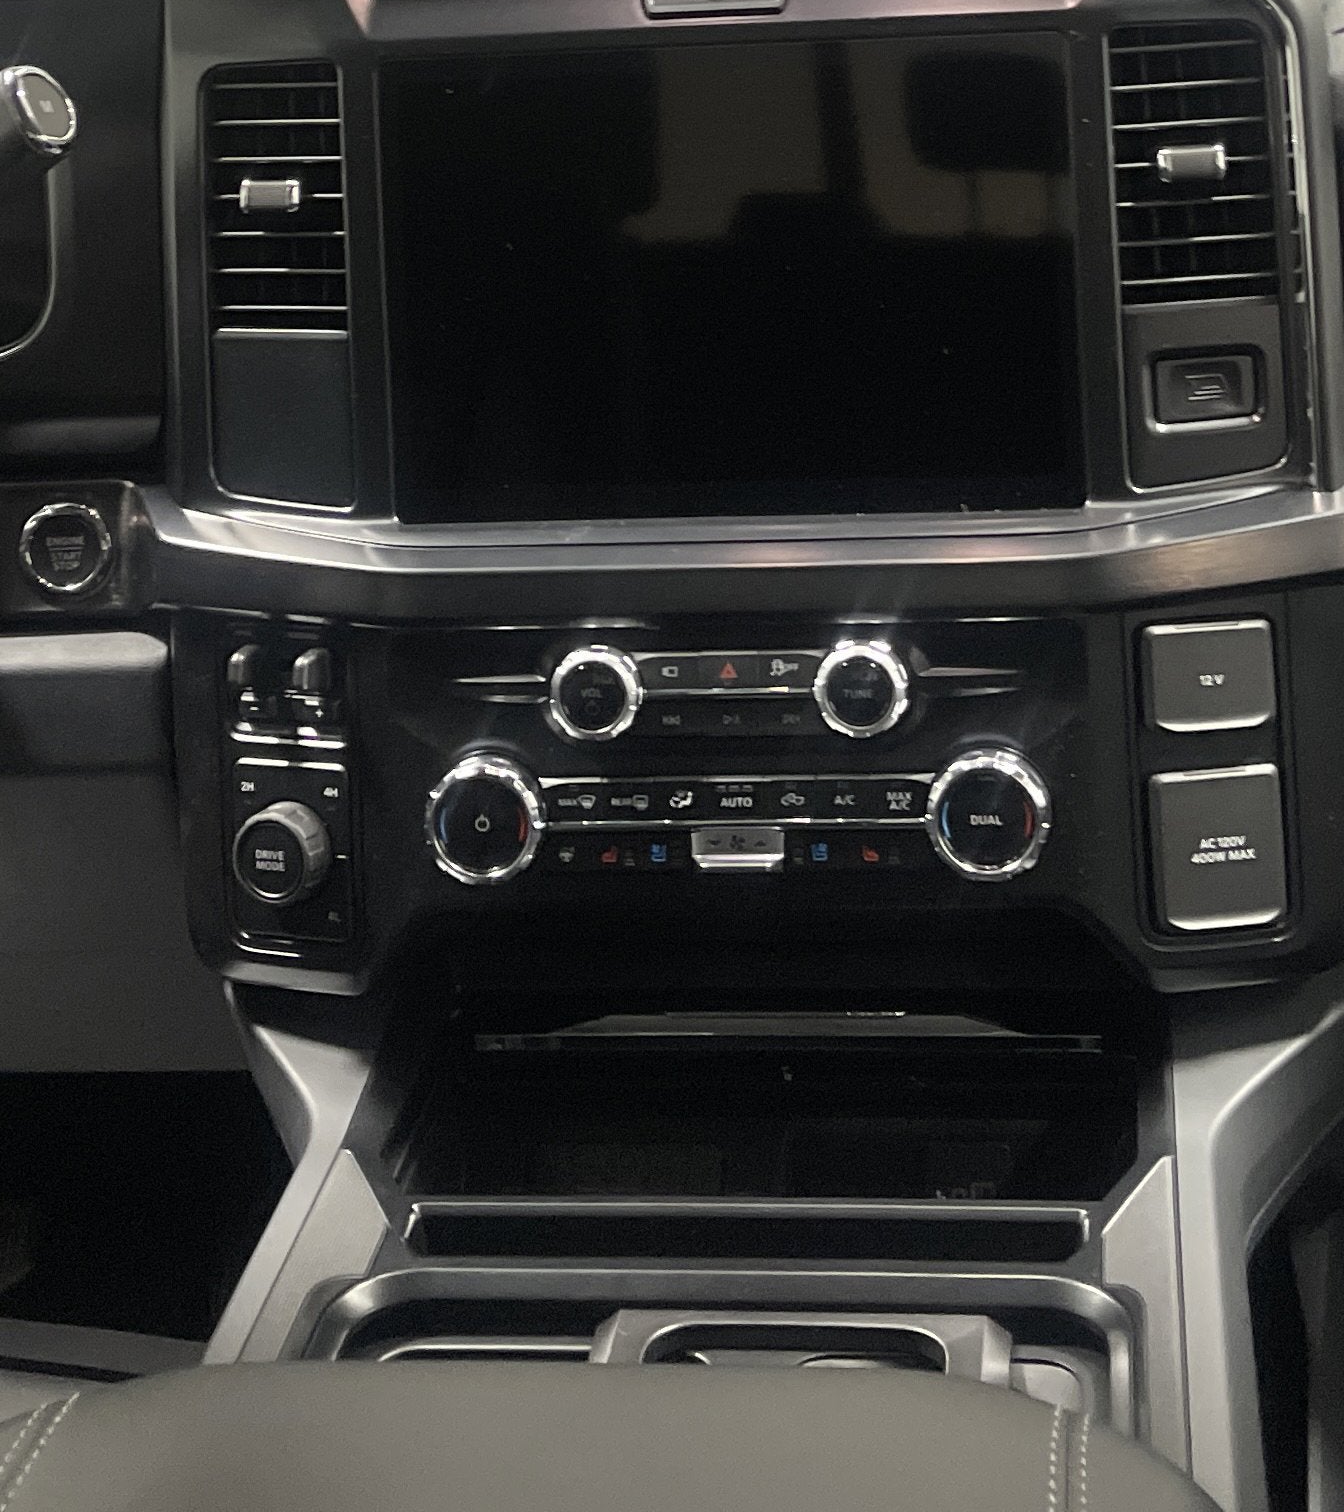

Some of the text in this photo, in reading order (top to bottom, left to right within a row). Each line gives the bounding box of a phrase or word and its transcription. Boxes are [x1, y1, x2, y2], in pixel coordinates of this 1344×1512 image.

[240, 781, 255, 792] 2H
[323, 787, 339, 798] 4H
[720, 796, 753, 808] AUTO
[834, 794, 856, 806] A/C
[886, 791, 913, 801] MAX
[888, 800, 911, 811] A/C
[969, 814, 1004, 826] DUAL
[1199, 837, 1217, 849] AC
[255, 848, 285, 861] DRIVE
[1190, 848, 1257, 864] 400W MAX
[255, 860, 286, 872] MODE
